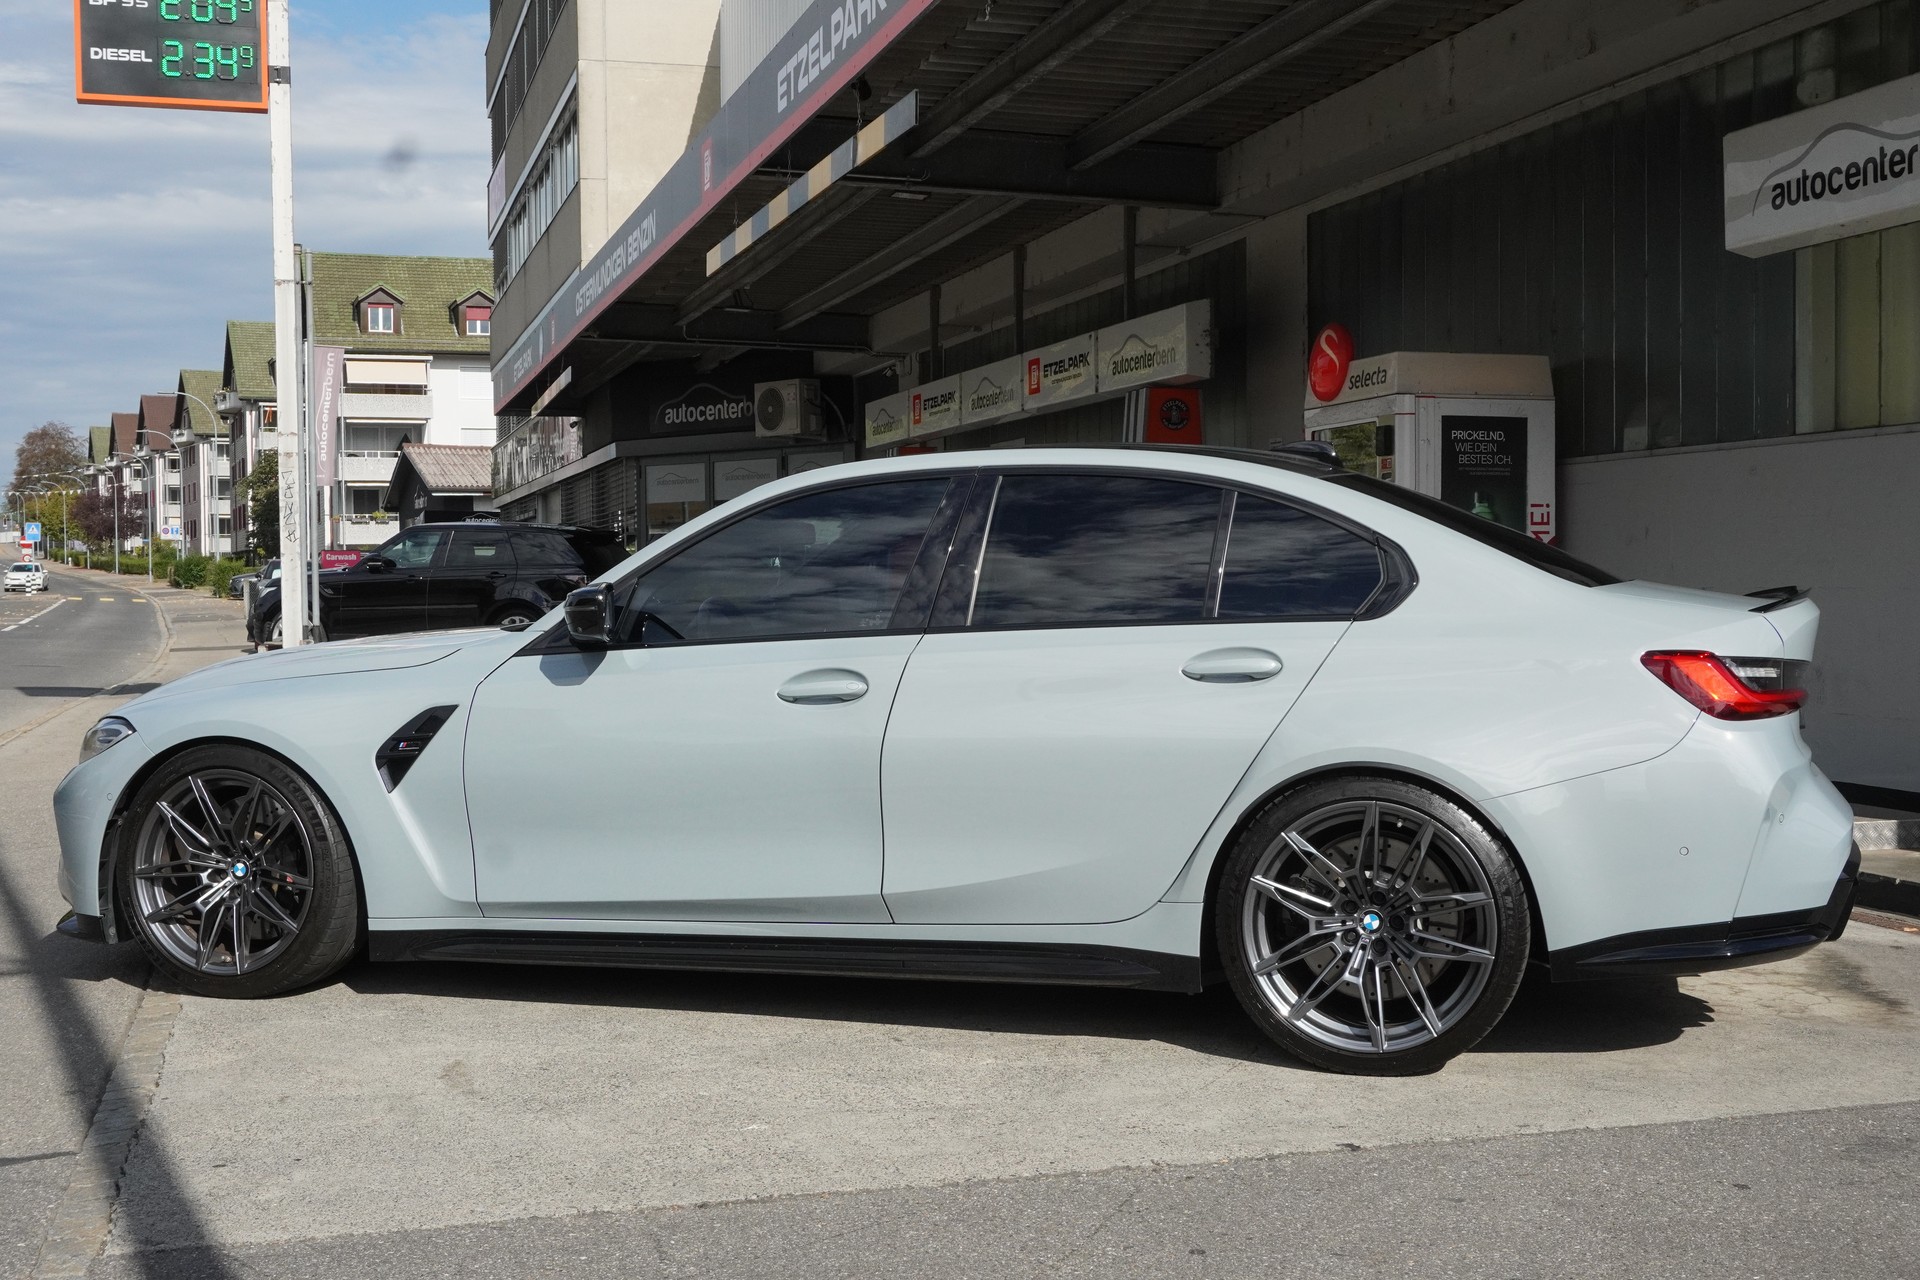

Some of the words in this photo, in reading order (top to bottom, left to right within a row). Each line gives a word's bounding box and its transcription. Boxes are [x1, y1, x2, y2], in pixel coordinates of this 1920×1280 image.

[90, 47, 153, 62] DIESEL
[575, 243, 627, 316] OSTERMUNDIGEN
[627, 209, 656, 266] BENZIN
[1043, 352, 1091, 378] ETZELPARK
[1112, 345, 1176, 376] autocenterbern
[1349, 366, 1387, 390] selecta
[319, 352, 335, 462] autocenterbern
[923, 390, 956, 411] ETZELPARK
[1451, 430, 1506, 442] PRICKELND,
[1454, 442, 1474, 452] WIE
[1474, 442, 1497, 452] DEIN
[1458, 454, 1493, 465] BESTES
[1494, 455, 1513, 465] ICH.
[325, 553, 357, 562] Carwash
